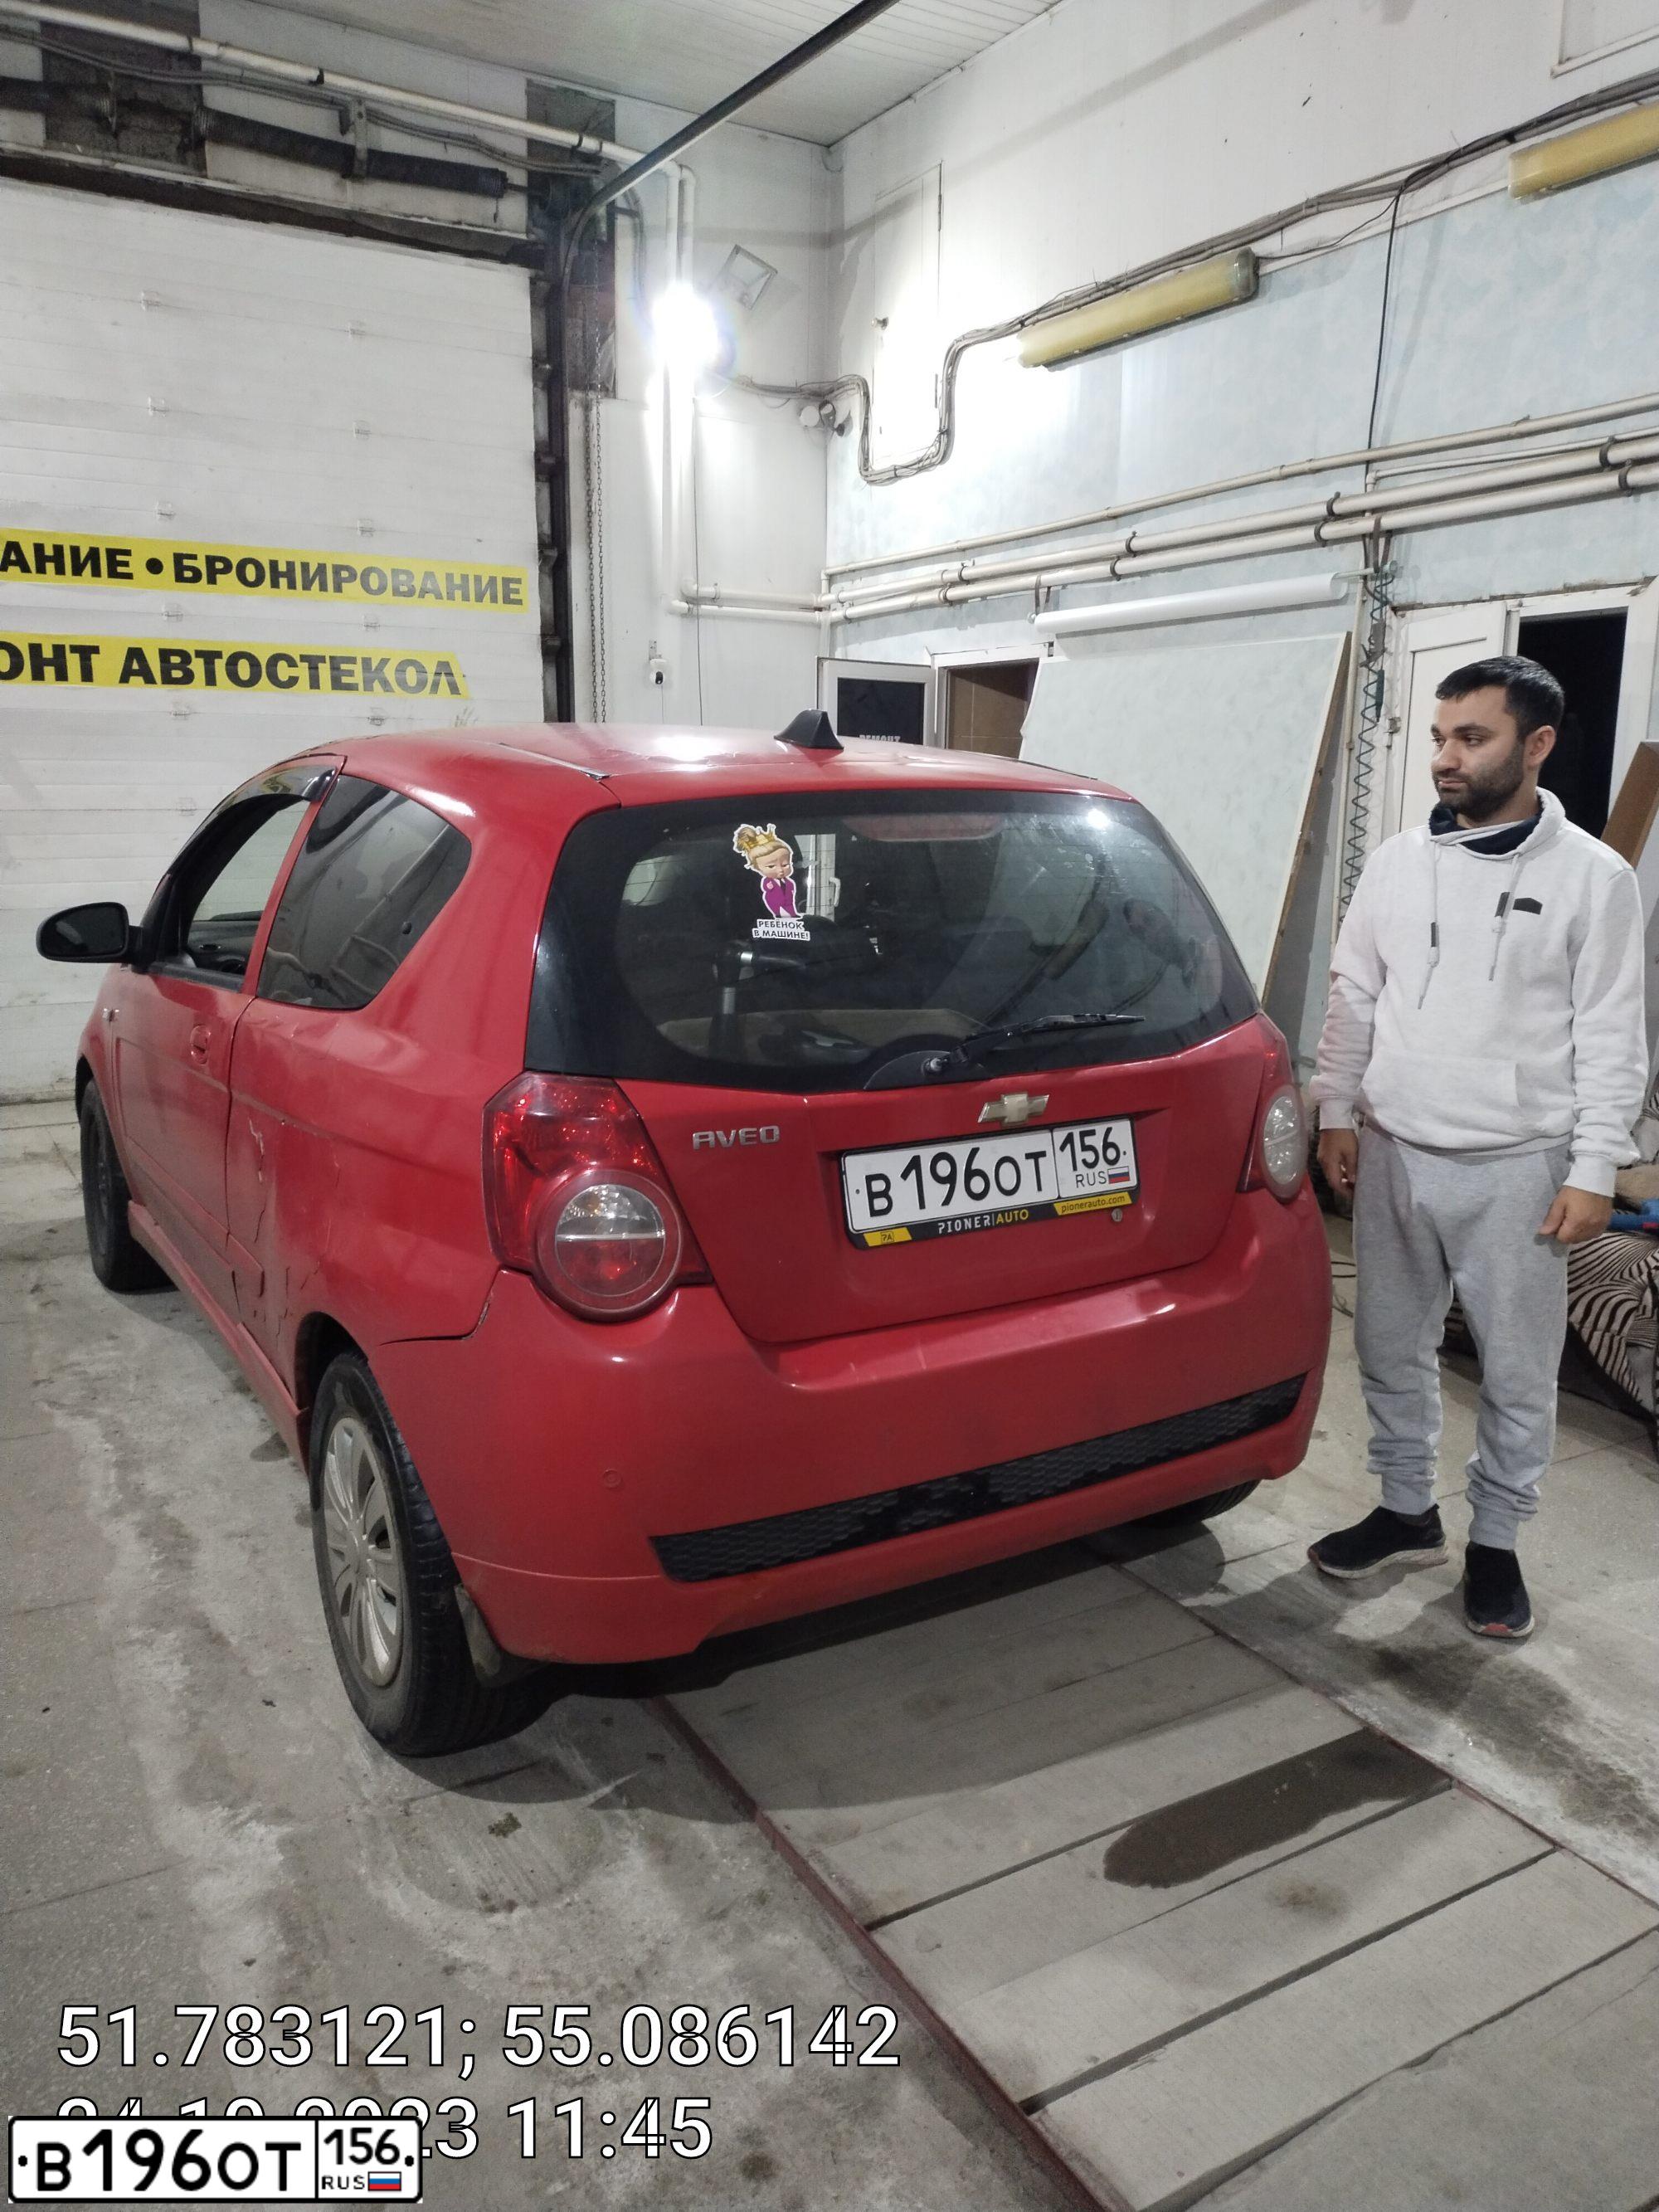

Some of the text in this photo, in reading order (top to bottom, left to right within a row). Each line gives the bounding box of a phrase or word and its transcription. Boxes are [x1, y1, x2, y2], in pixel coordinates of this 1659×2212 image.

[173, 553, 523, 606] БРОНИРОВАНИЕ
[119, 646, 462, 695] АВТОСТЕКОЛ
[758, 919, 802, 929] РЕБЁНОК
[762, 930, 809, 939] МАШИНЕ!
[693, 1125, 780, 1150] AVEO
[1059, 1127, 1121, 1172] 156
[1075, 1171, 1107, 1189] RUS
[1062, 1195, 1125, 1213] pionerauto.com
